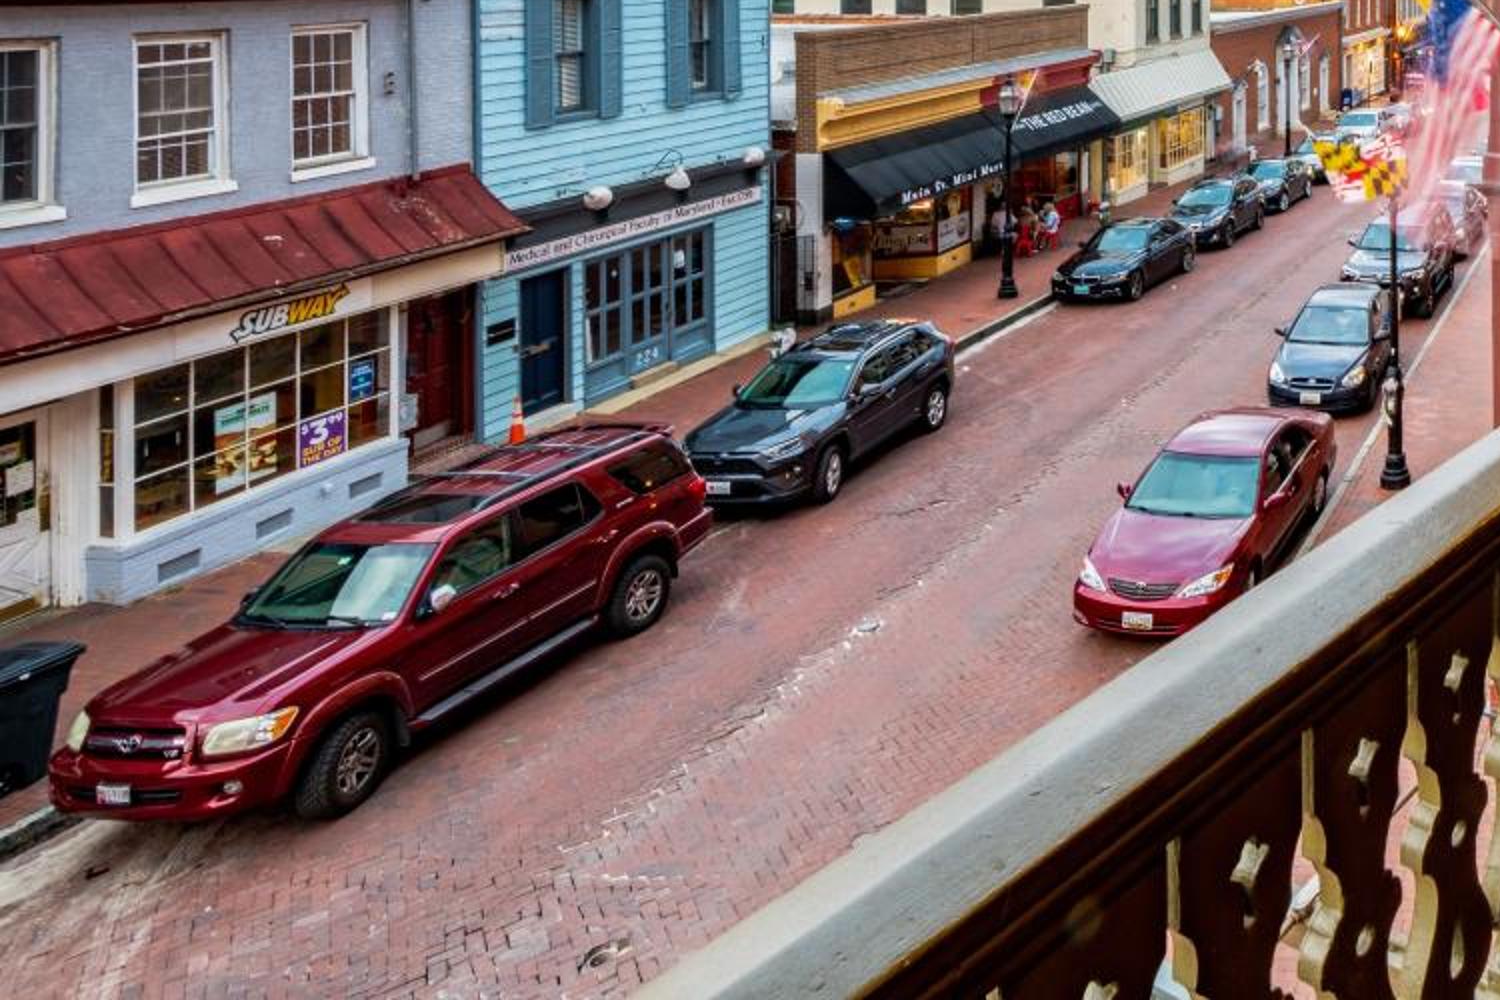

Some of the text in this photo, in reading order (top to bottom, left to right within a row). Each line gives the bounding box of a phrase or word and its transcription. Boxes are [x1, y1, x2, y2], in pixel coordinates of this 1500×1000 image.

[1020, 114, 1049, 132] THE
[1042, 109, 1067, 125] RED
[1062, 101, 1094, 119] BEAN
[902, 187, 931, 204] Main
[953, 169, 977, 186] Mini
[509, 242, 550, 265] Medical
[553, 240, 572, 254] and
[675, 198, 714, 217] Maryland
[230, 284, 350, 343] SUBWAY
